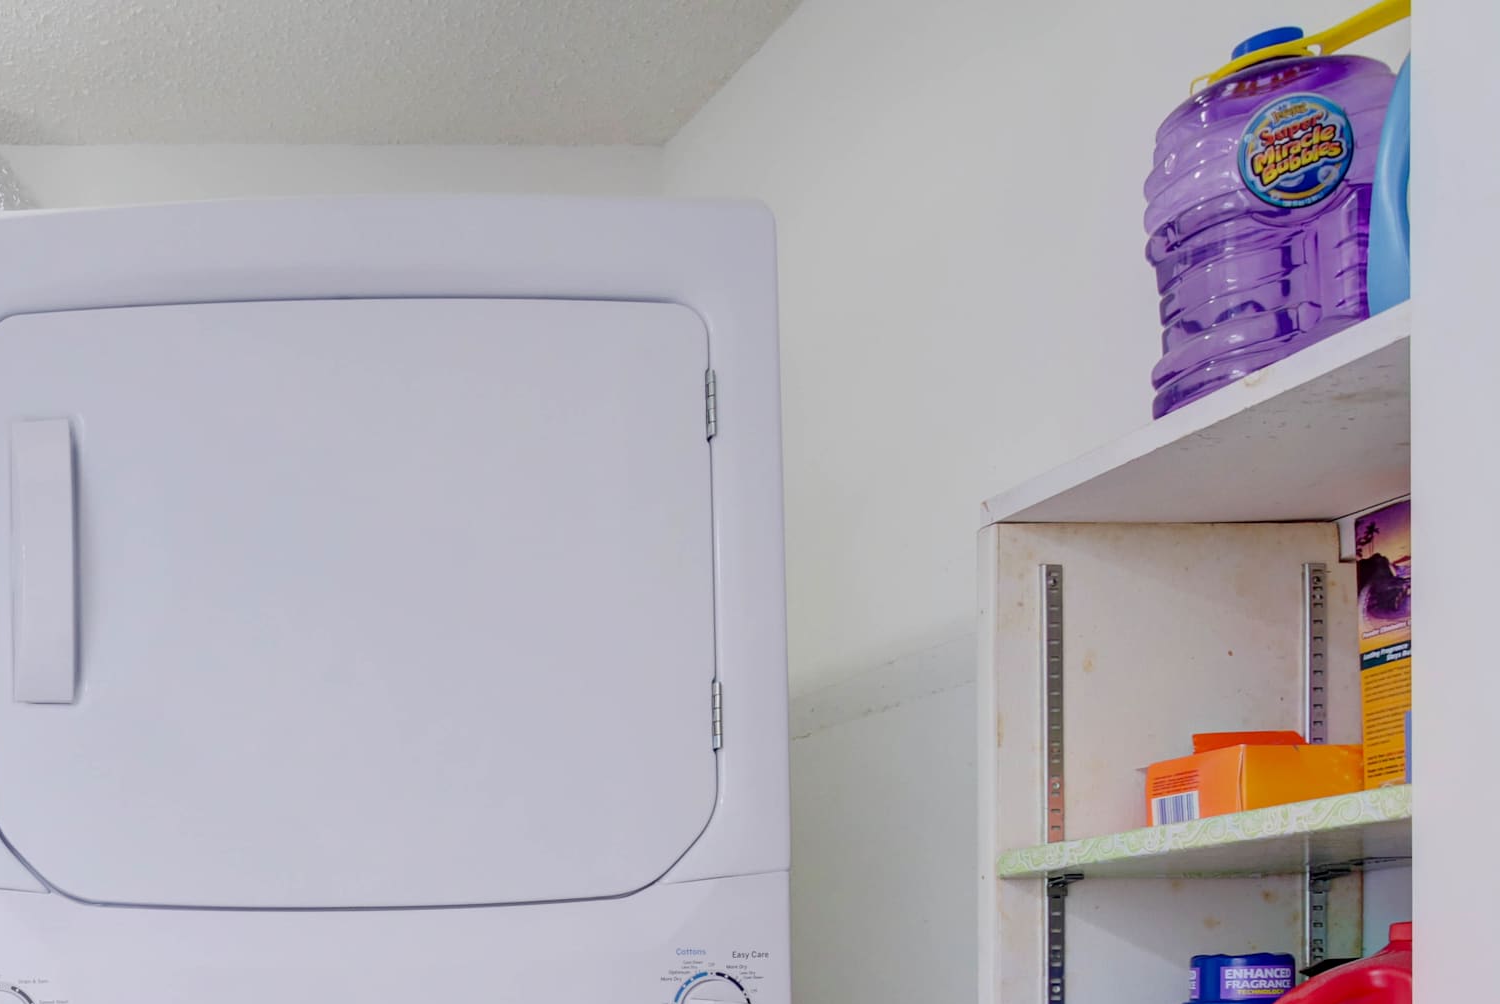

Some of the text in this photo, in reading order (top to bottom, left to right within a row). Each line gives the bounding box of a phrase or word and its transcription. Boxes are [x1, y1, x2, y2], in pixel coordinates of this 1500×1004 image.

[1260, 111, 1325, 146] Super
[1252, 124, 1337, 176] Miracle
[1260, 140, 1343, 187] Bubbles
[675, 948, 706, 956] Cottons
[732, 951, 749, 959] Easy
[1225, 968, 1291, 979] ENHANCED
[1225, 979, 1291, 989] FRAGRANCE
